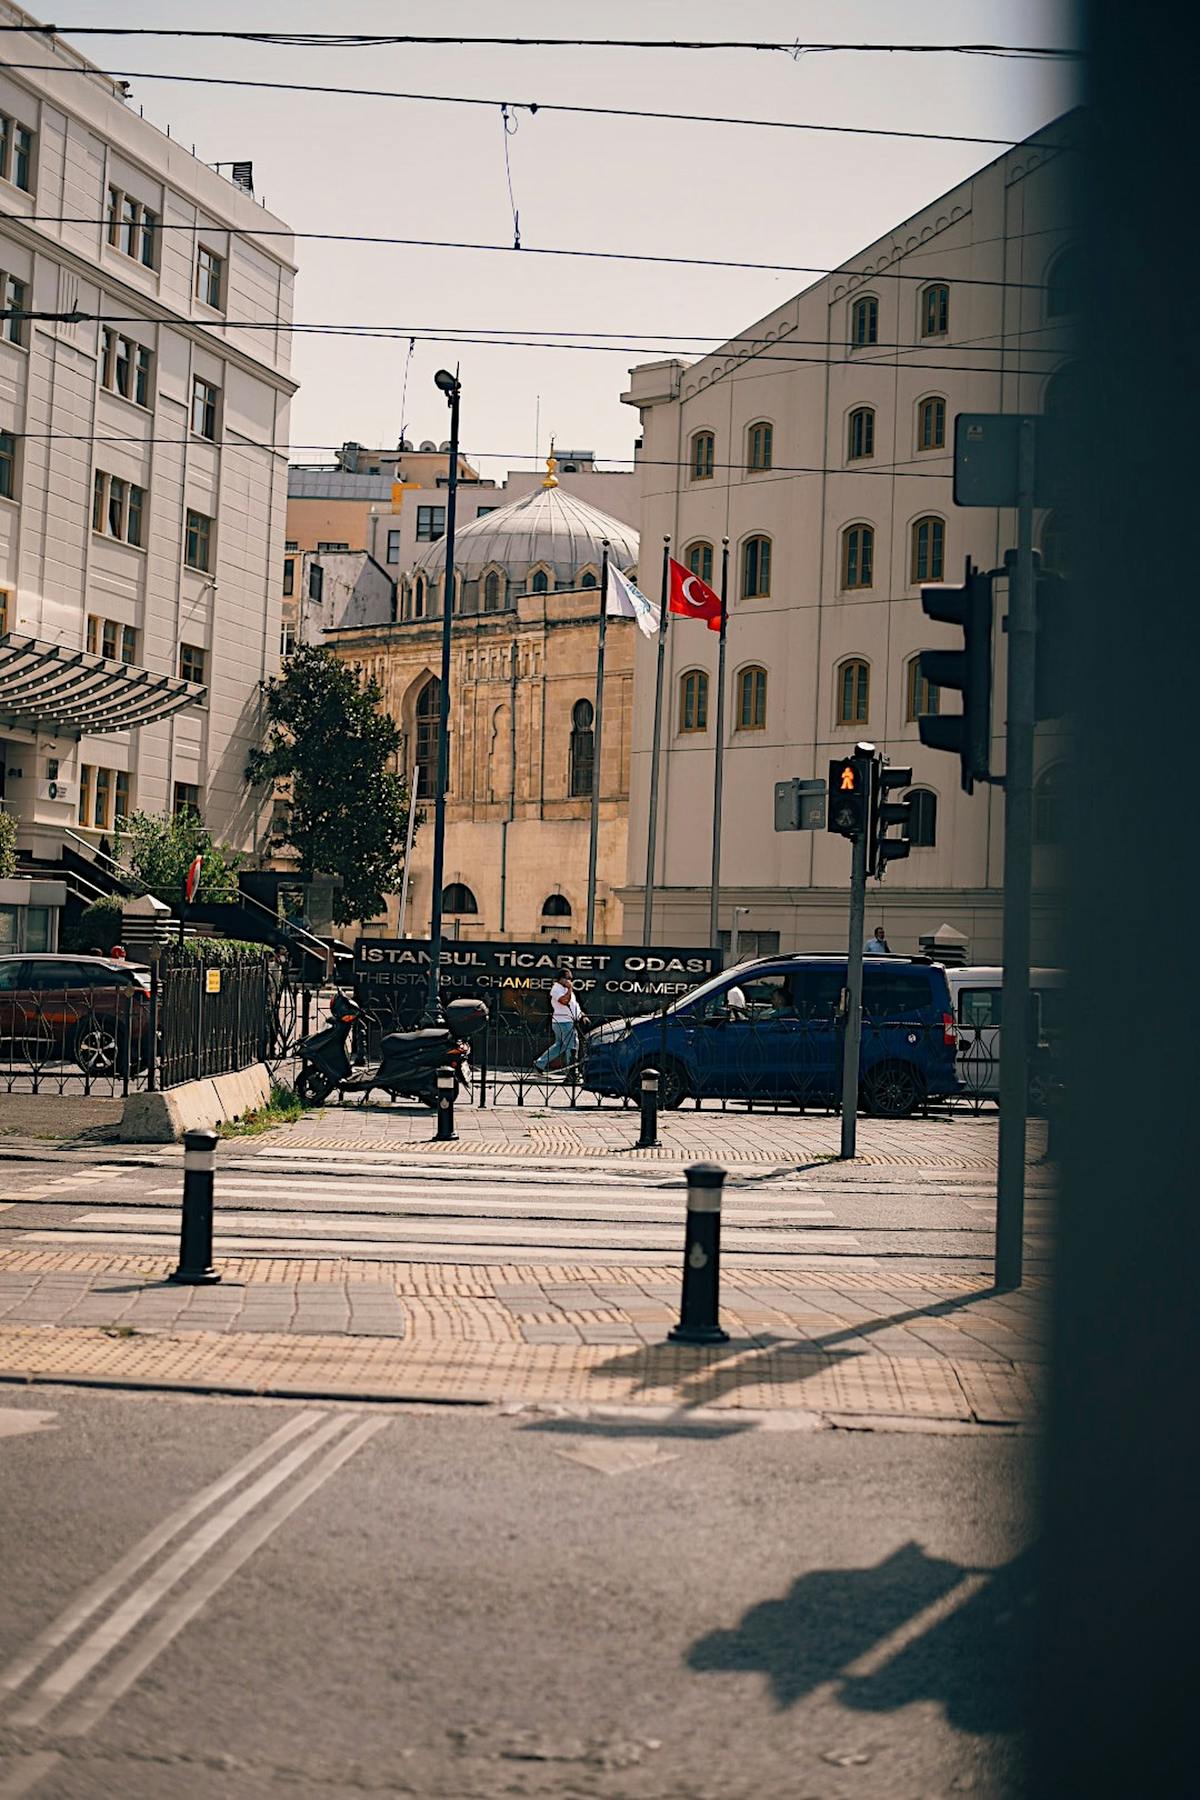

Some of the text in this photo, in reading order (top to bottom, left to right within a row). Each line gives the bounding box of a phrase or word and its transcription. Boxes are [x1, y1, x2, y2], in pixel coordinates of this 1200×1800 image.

[494, 951, 610, 970] TİCARET
[625, 957, 712, 973] ODASI
[356, 972, 699, 995] THE ISTABUL CHAMBE OF COMMER
